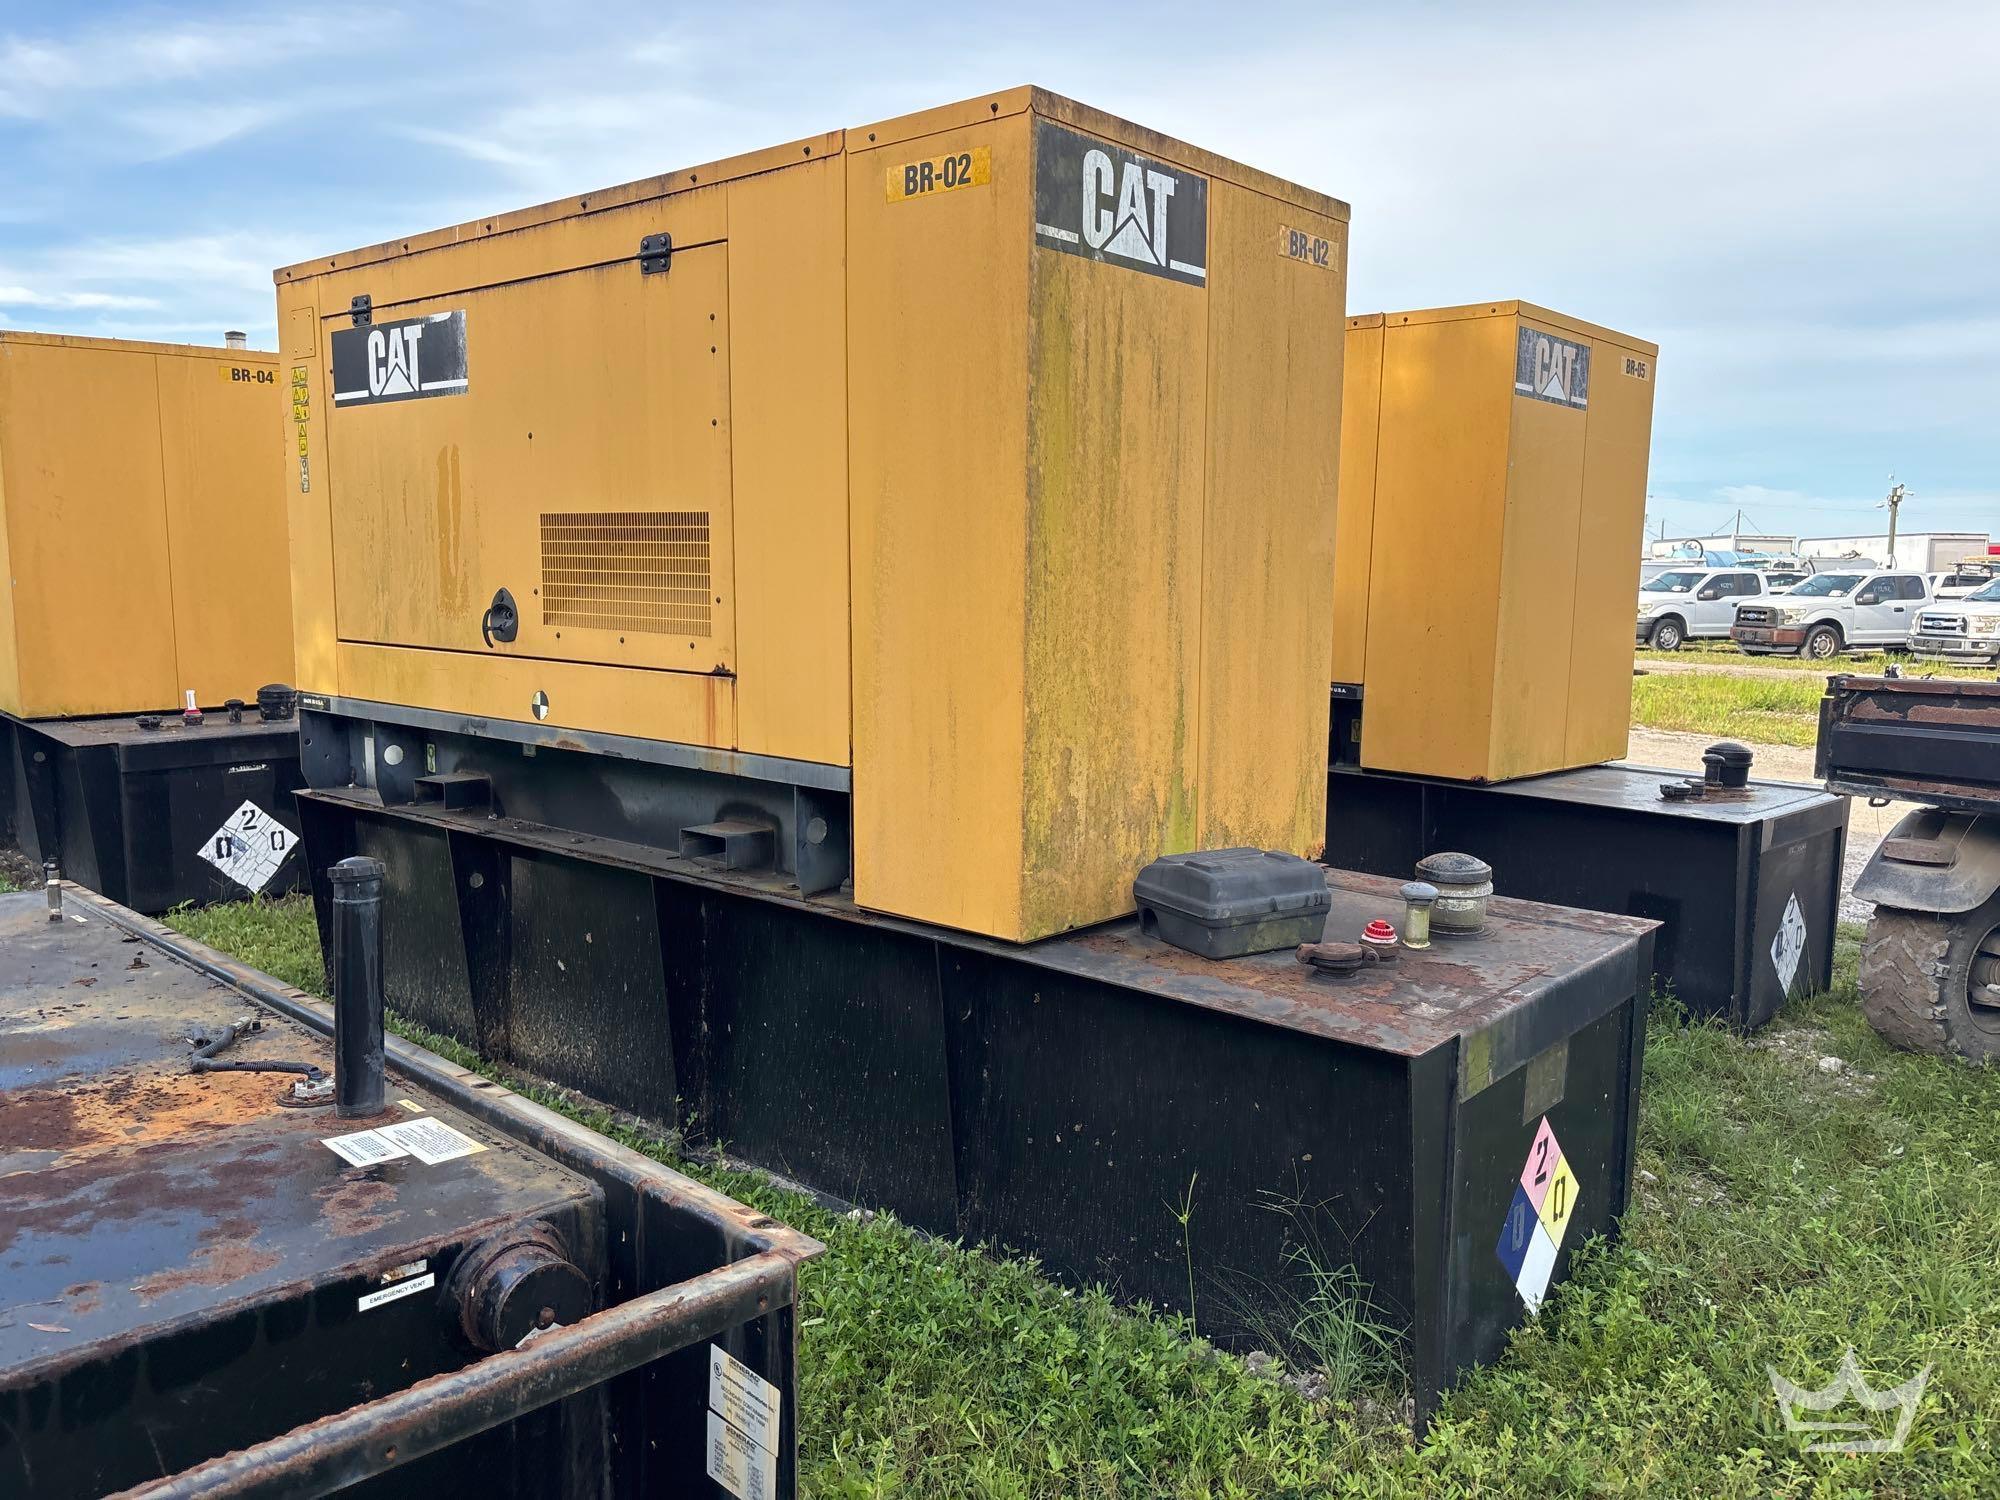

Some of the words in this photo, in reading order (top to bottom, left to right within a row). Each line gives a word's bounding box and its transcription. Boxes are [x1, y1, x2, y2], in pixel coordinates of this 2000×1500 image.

[905, 154, 971, 196] BR-02
[1082, 149, 1175, 267] CAT
[1289, 230, 1329, 266] BR-02
[231, 368, 274, 384] BR-04
[368, 325, 422, 397] CAT
[1534, 338, 1577, 401] CAT
[1625, 359, 1646, 379] BR-05
[242, 809, 257, 831] 2
[216, 836, 232, 859] 0
[270, 830, 285, 851] 0
[1788, 898, 1796, 923] 2
[1534, 1136, 1549, 1187] 2
[1512, 1202, 1525, 1251] 0
[1553, 1175, 1566, 1223] 0
[369, 1286, 409, 1304] EMERGENCY
[409, 1280, 426, 1290] VENT
